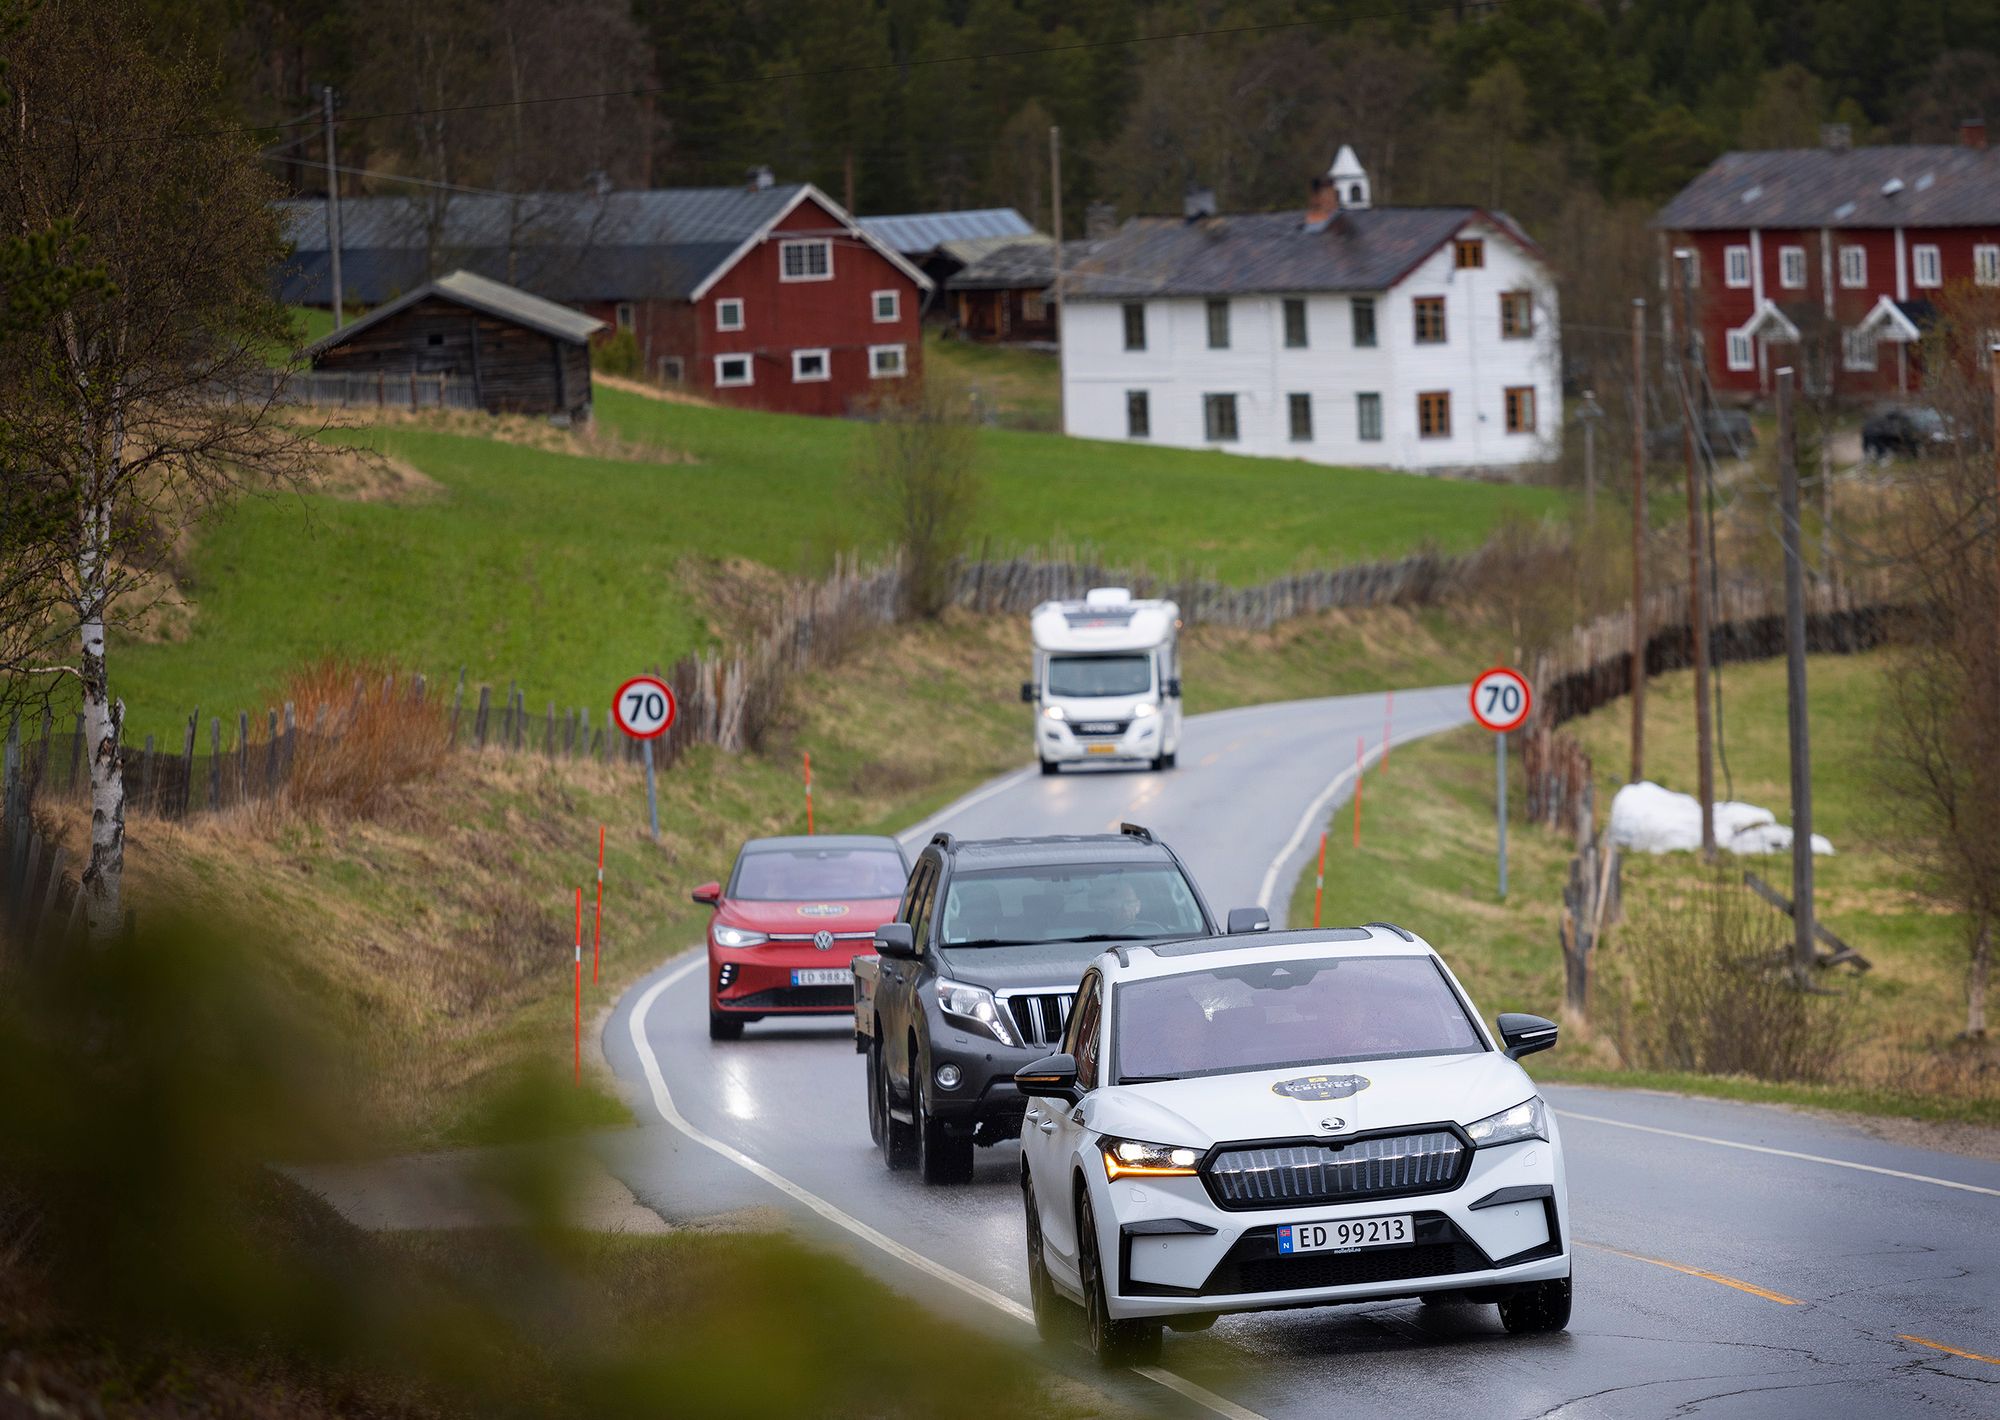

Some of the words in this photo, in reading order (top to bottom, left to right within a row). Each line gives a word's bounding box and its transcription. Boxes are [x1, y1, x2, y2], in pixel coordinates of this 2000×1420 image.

[627, 692, 664, 722] 70
[1485, 685, 1520, 714] 70
[801, 972, 815, 983] ED
[1299, 1226, 1327, 1248] ED
[1337, 1219, 1405, 1245] 99213
